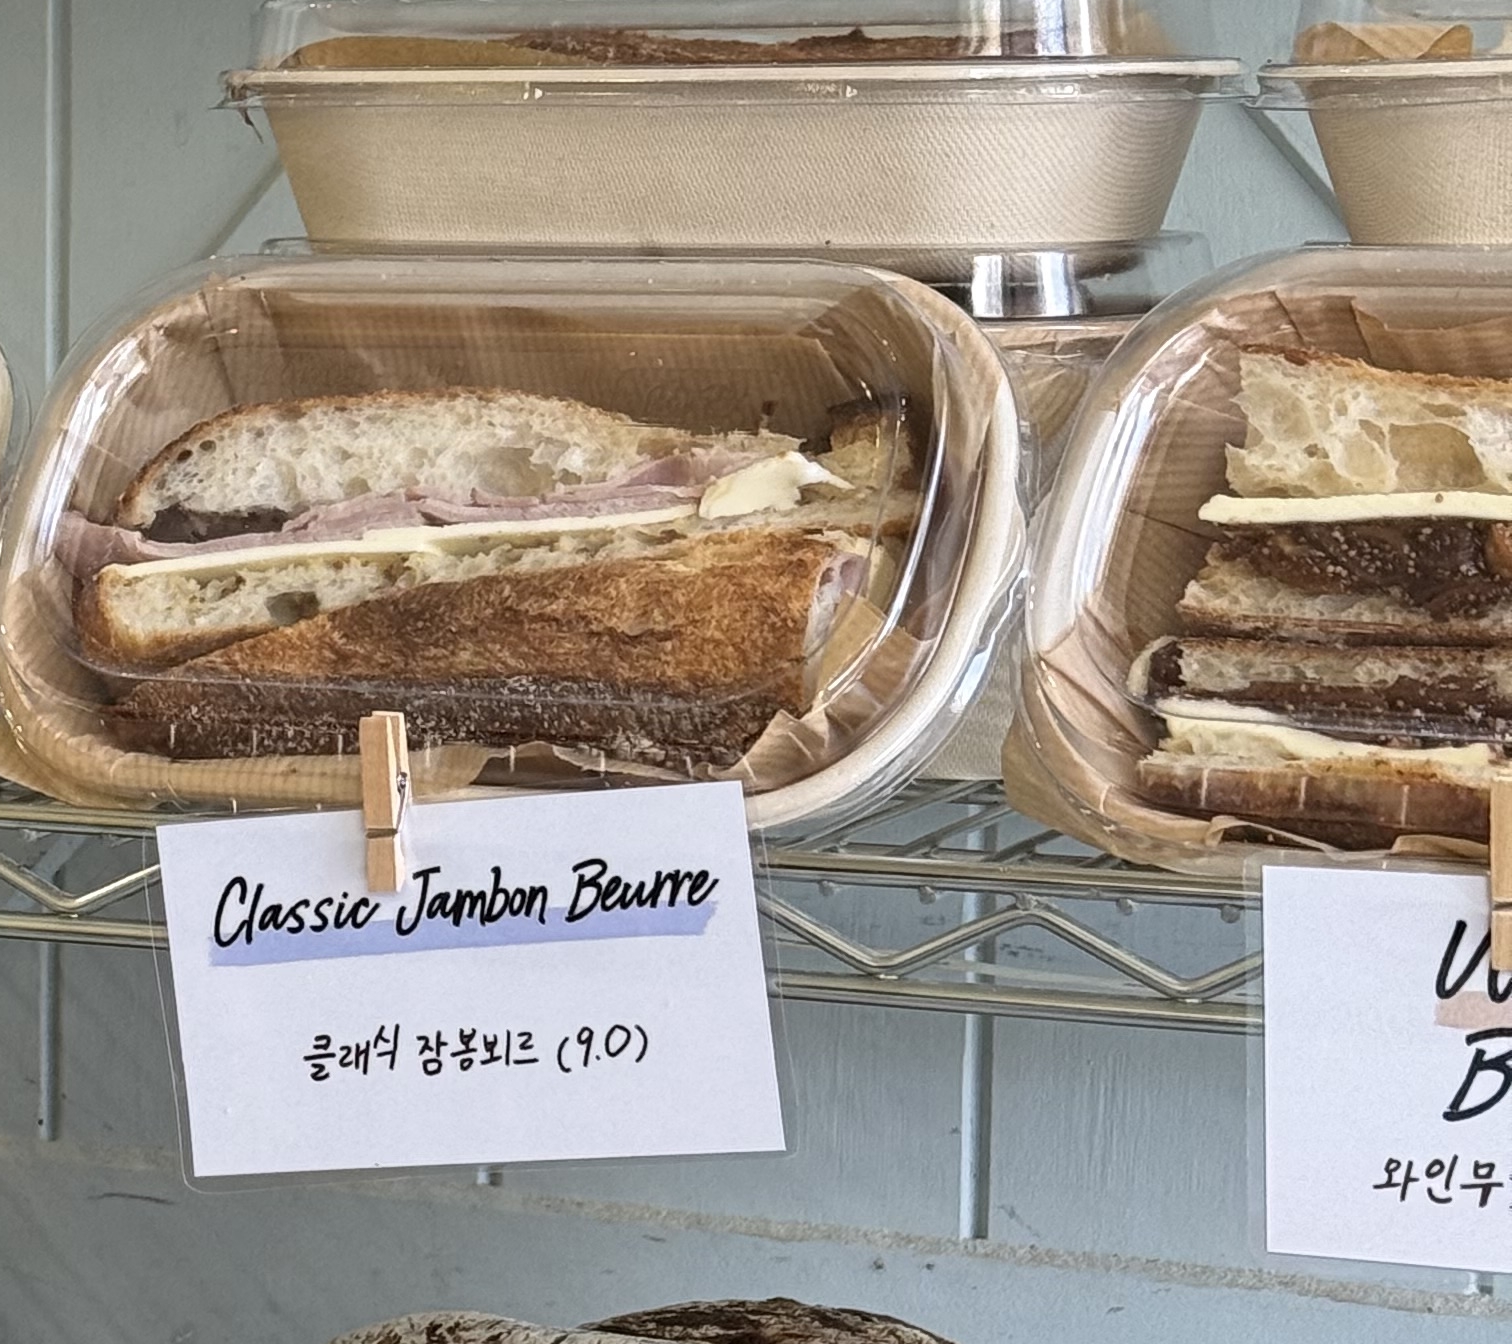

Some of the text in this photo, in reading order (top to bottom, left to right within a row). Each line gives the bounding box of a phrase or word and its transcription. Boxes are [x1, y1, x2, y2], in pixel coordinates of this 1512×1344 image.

[213, 858, 720, 948] Classic Jambon Beurre
[303, 1023, 650, 1082] 클래식 잠봉뵈르 (9.0)
[1372, 1154, 1512, 1209] 와인무
